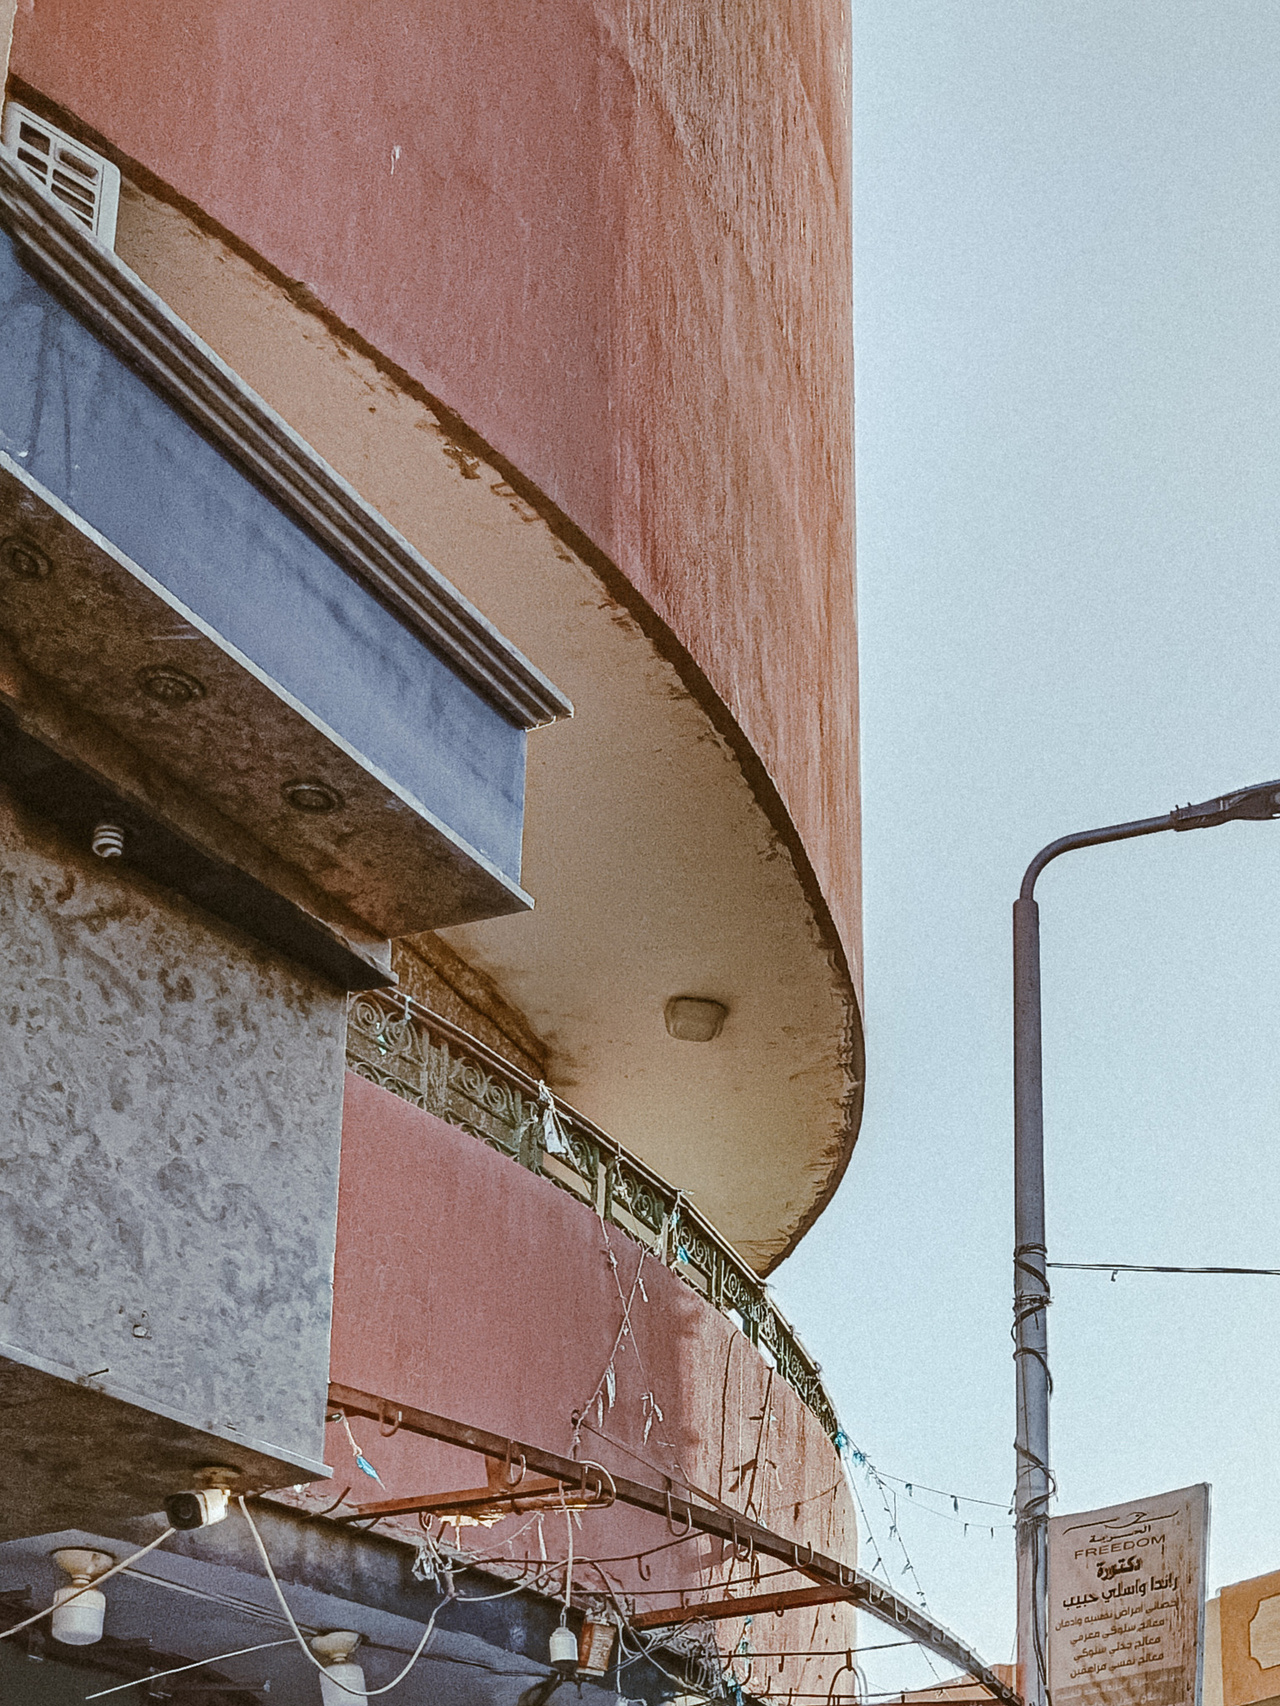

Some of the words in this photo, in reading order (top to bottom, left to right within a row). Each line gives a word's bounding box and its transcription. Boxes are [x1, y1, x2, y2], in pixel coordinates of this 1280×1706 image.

[1074, 1534, 1165, 1559] FREEDOM
[1096, 1555, 1143, 1581] دكتورة
[1062, 1593, 1099, 1610] حبيب
